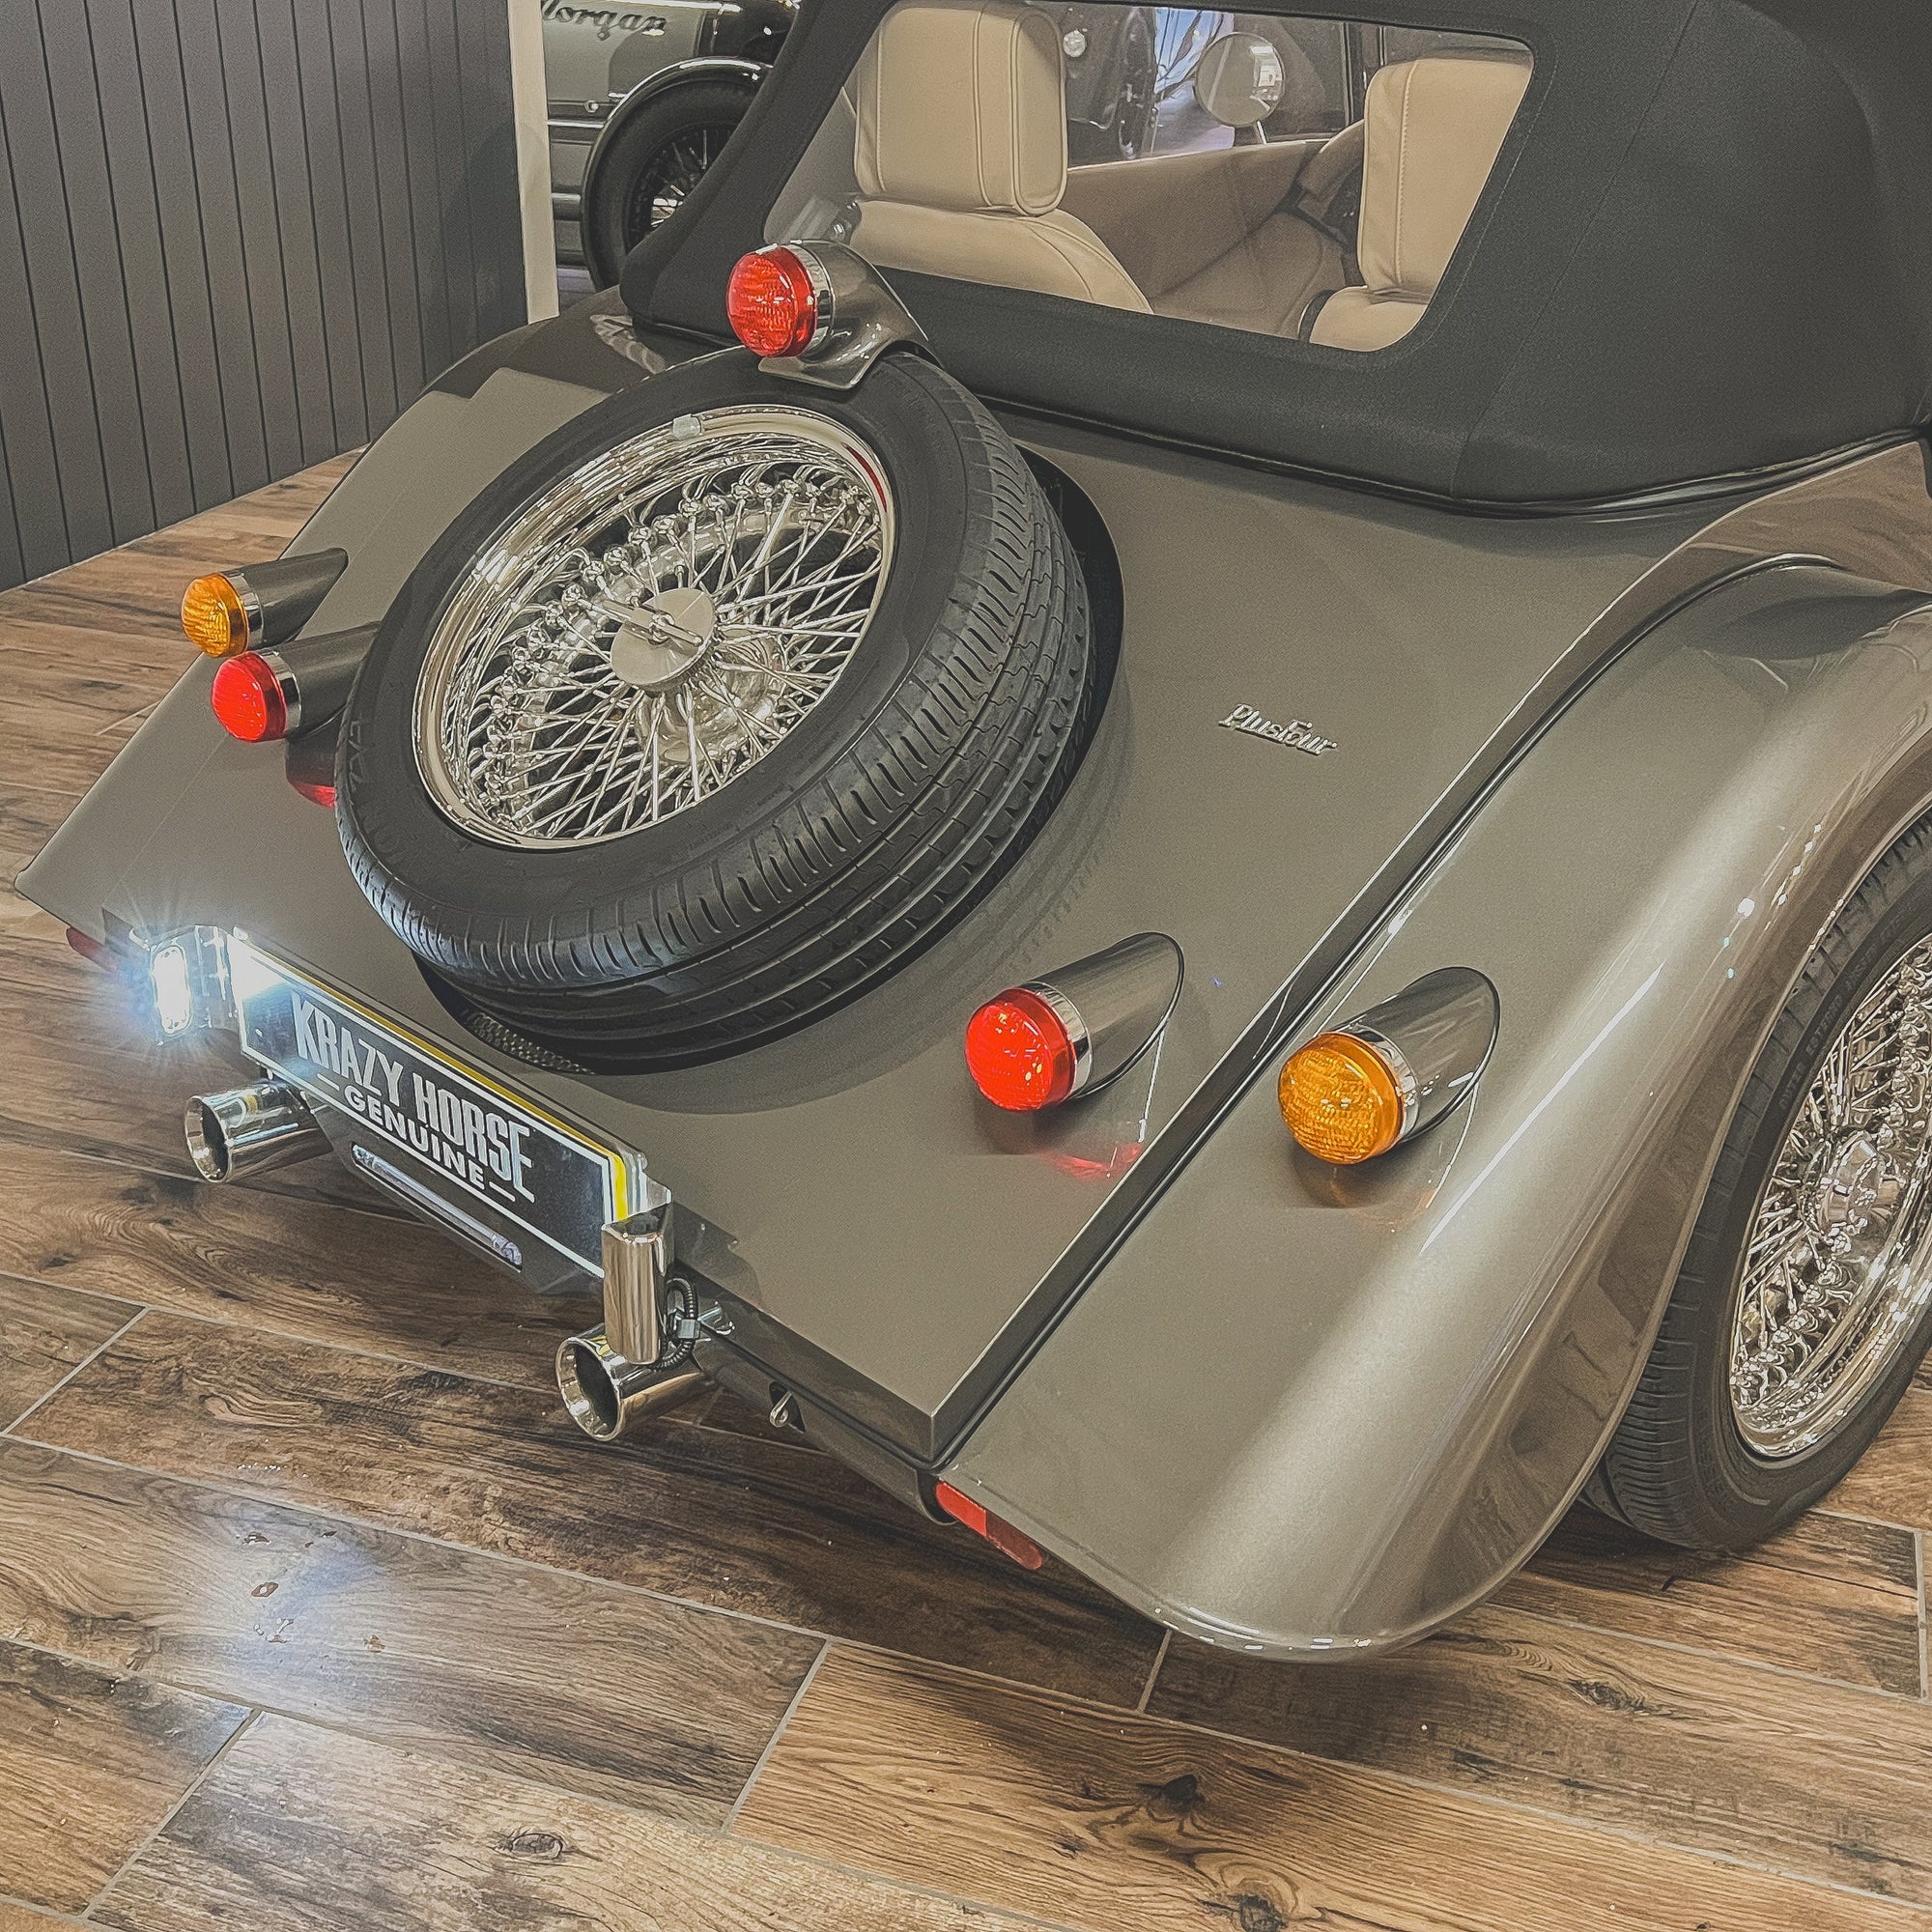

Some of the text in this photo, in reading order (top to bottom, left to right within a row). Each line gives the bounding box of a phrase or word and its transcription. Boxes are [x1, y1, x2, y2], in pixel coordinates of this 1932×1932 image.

[292, 992, 535, 1204] KRAZY HORSE
[344, 1085, 486, 1190] GENUINE
